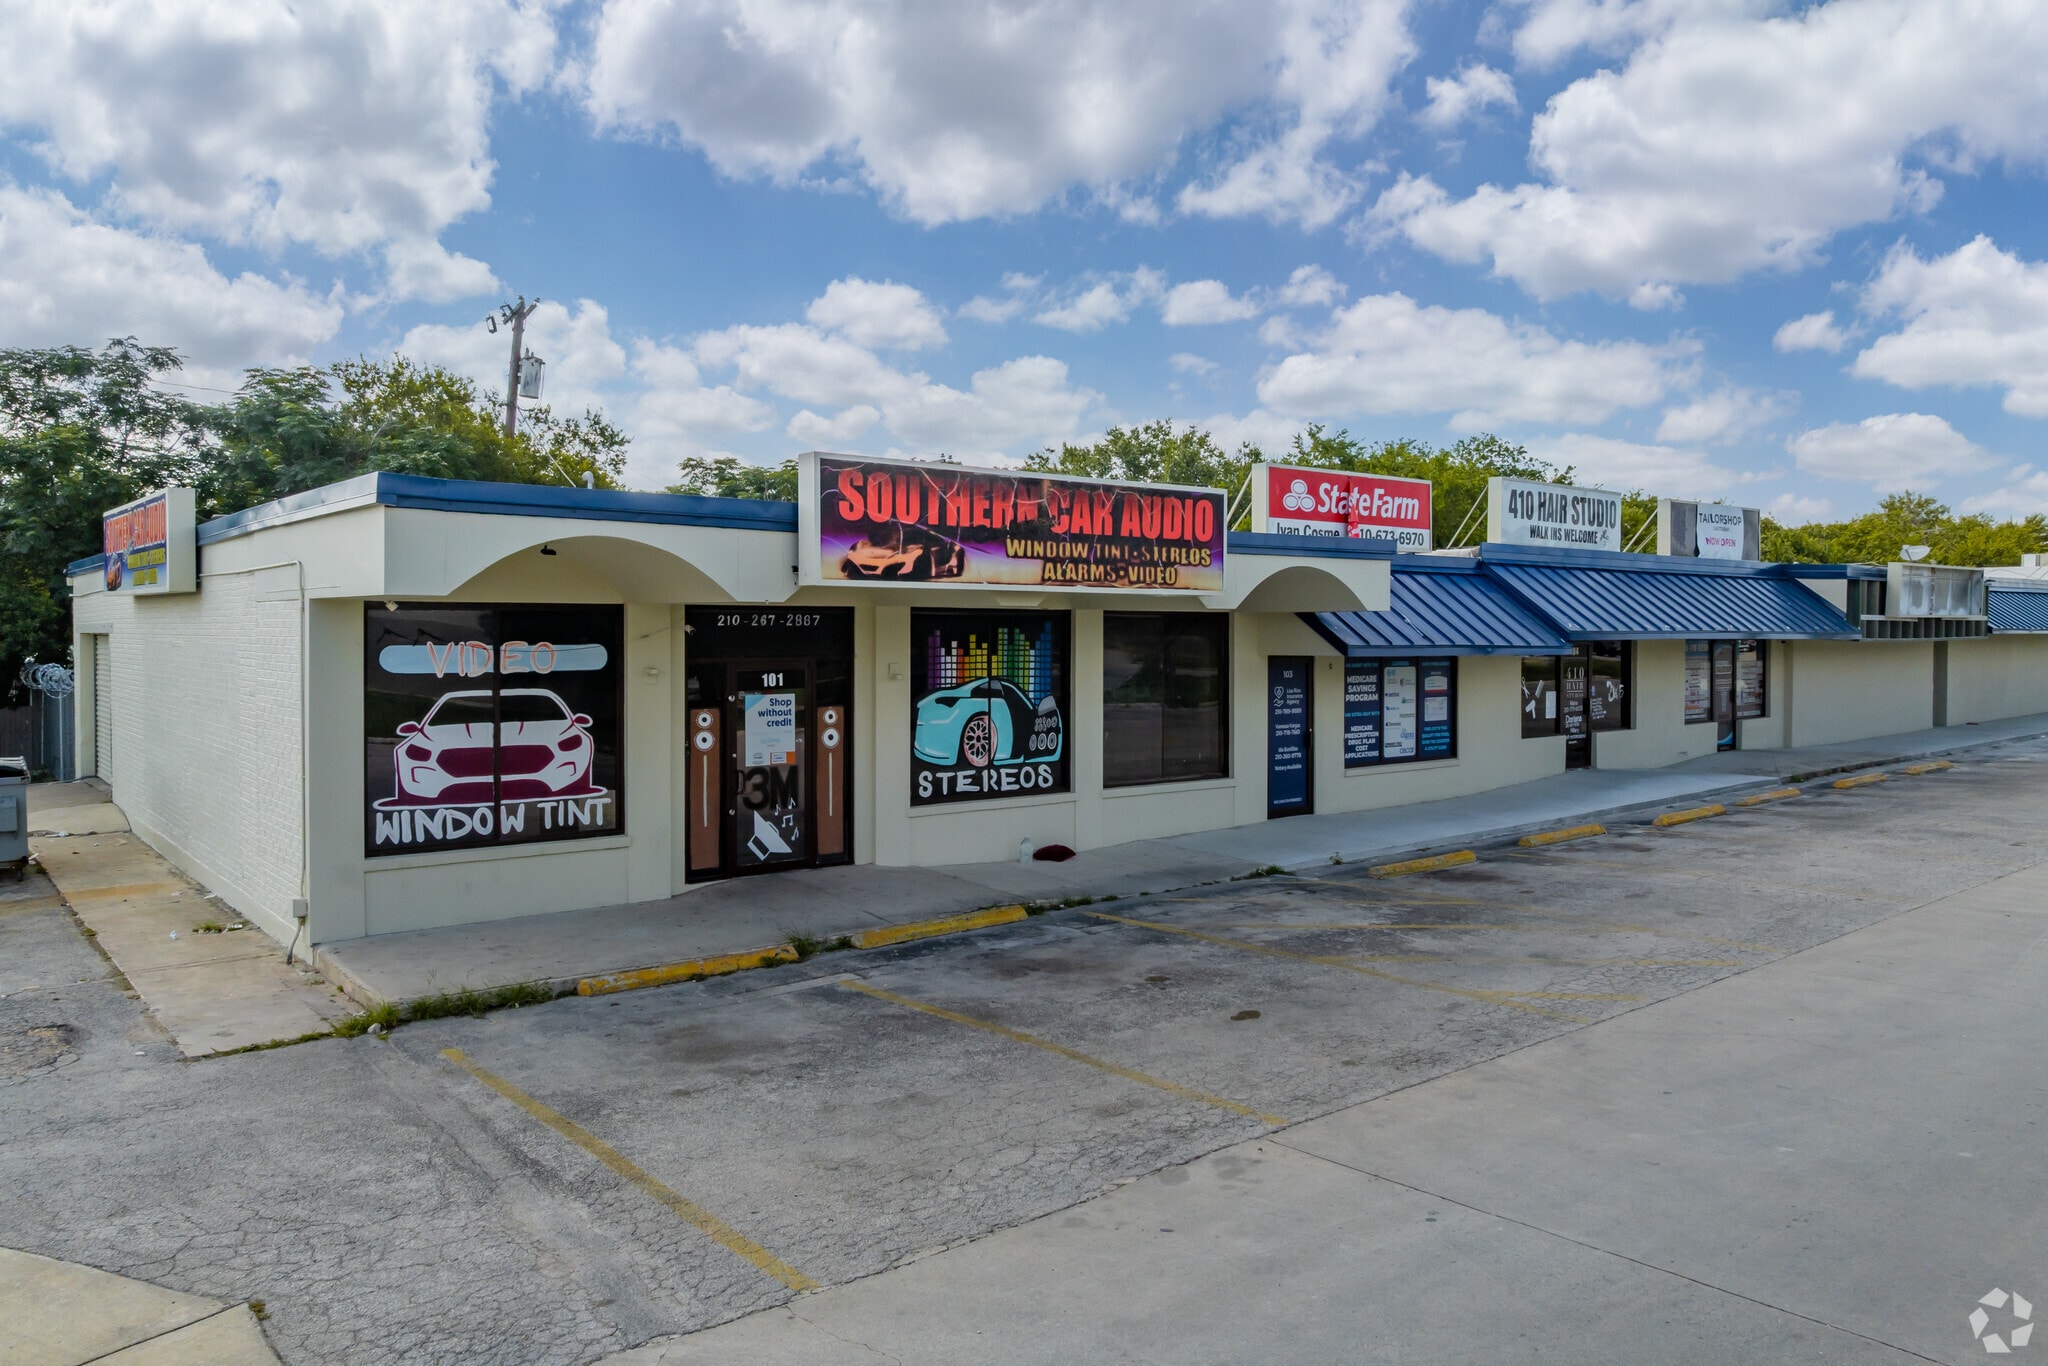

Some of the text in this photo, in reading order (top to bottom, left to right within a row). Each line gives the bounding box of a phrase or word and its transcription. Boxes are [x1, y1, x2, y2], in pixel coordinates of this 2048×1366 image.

[838, 469, 1214, 543] SOUTHERN CAR AUDIO
[1508, 489, 1617, 529] 410 HAIR STUDIO
[1277, 522, 1300, 535] Ivan
[1303, 524, 1340, 538] Cosme
[1530, 524, 1598, 545] WALK INS WELCOME
[1705, 537, 1736, 547] NOW OPEN
[1006, 537, 1089, 559] WINDOW
[1141, 546, 1211, 566] STEREOS
[1043, 562, 1177, 585] ALARMS VIDEO
[427, 641, 557, 678] VIDEO
[761, 672, 784, 687] 101
[1347, 675, 1377, 683] MEDICARE
[1566, 666, 1584, 680] 410
[1348, 685, 1376, 693] SAVINGS
[1566, 682, 1584, 690] HAIR
[769, 697, 792, 708] Shop
[1346, 694, 1379, 702] PROGRAM
[757, 708, 792, 717] without
[766, 717, 792, 727] credit
[1345, 731, 1379, 739] PRESCRIPTION
[1345, 751, 1380, 759] APPLICATIONS
[742, 764, 799, 811] 3M
[918, 764, 1054, 798] STEREOS
[376, 797, 612, 845] WINDOW TINT
